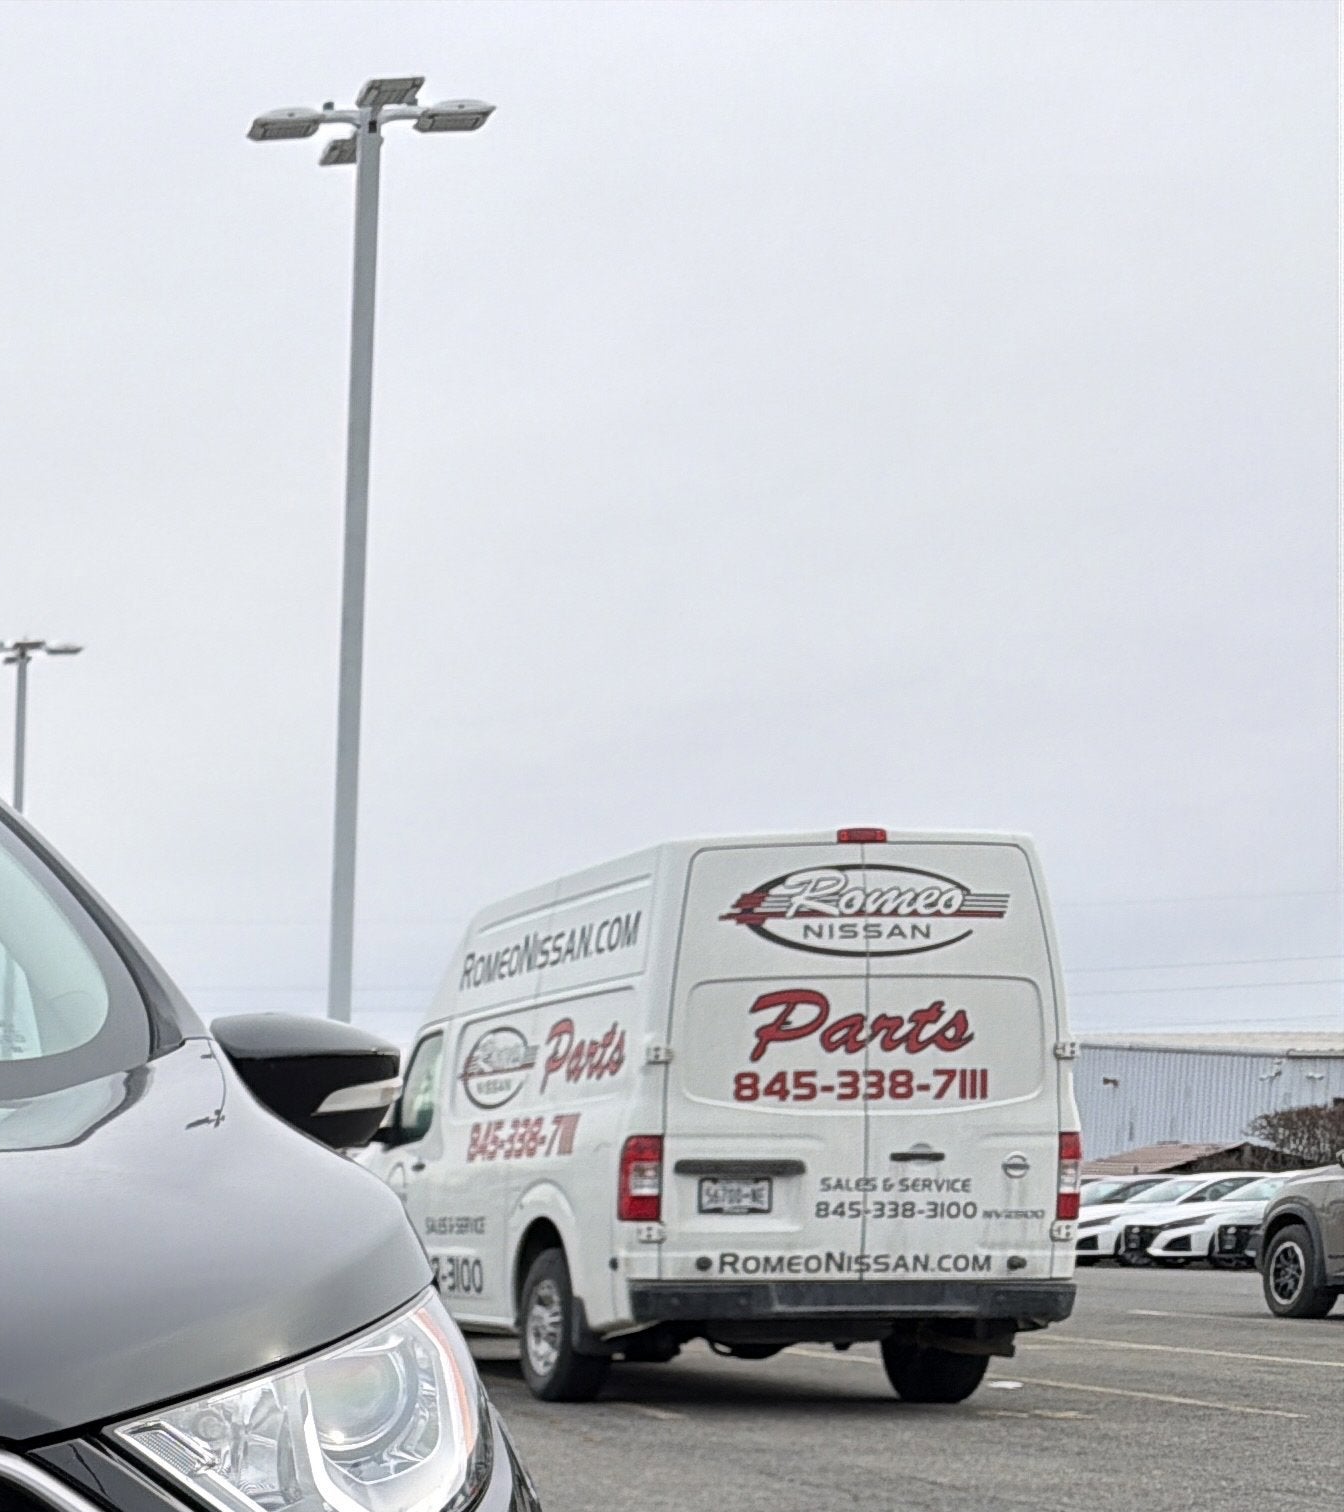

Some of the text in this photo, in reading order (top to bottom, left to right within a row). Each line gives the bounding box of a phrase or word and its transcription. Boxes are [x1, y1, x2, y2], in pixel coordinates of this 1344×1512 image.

[782, 868, 964, 919] Romeo
[802, 922, 932, 940] NISSAN
[748, 987, 975, 1063] Parts
[539, 1017, 626, 1096] Parts
[733, 1067, 989, 1102] 845-338-7111
[819, 1176, 973, 1193] SALES & SERVICE
[814, 1200, 978, 1220] 845-338-3100
